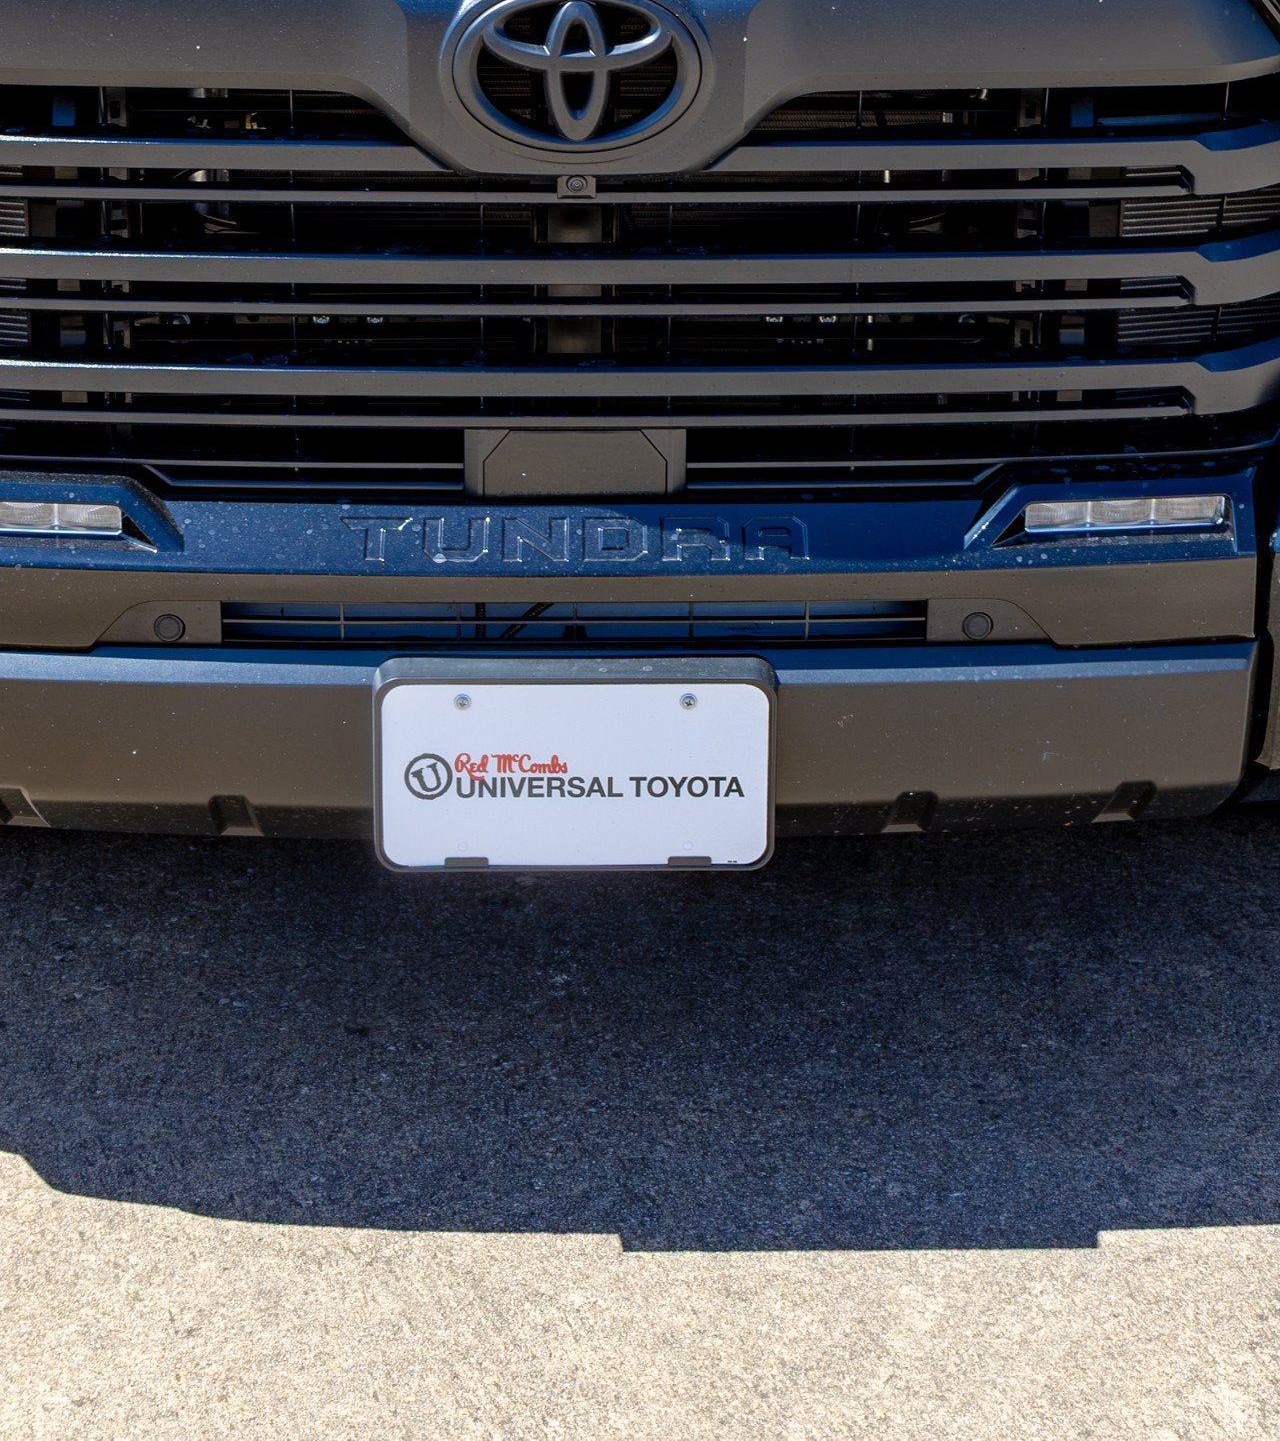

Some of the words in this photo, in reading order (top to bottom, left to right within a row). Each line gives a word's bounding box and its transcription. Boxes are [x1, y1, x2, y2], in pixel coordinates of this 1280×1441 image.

[340, 516, 810, 561] TUNDRA
[454, 752, 489, 781] Red
[491, 753, 569, 774] McCombs
[455, 776, 624, 799] UNIVERSAL
[628, 775, 746, 799] TOYOTA
